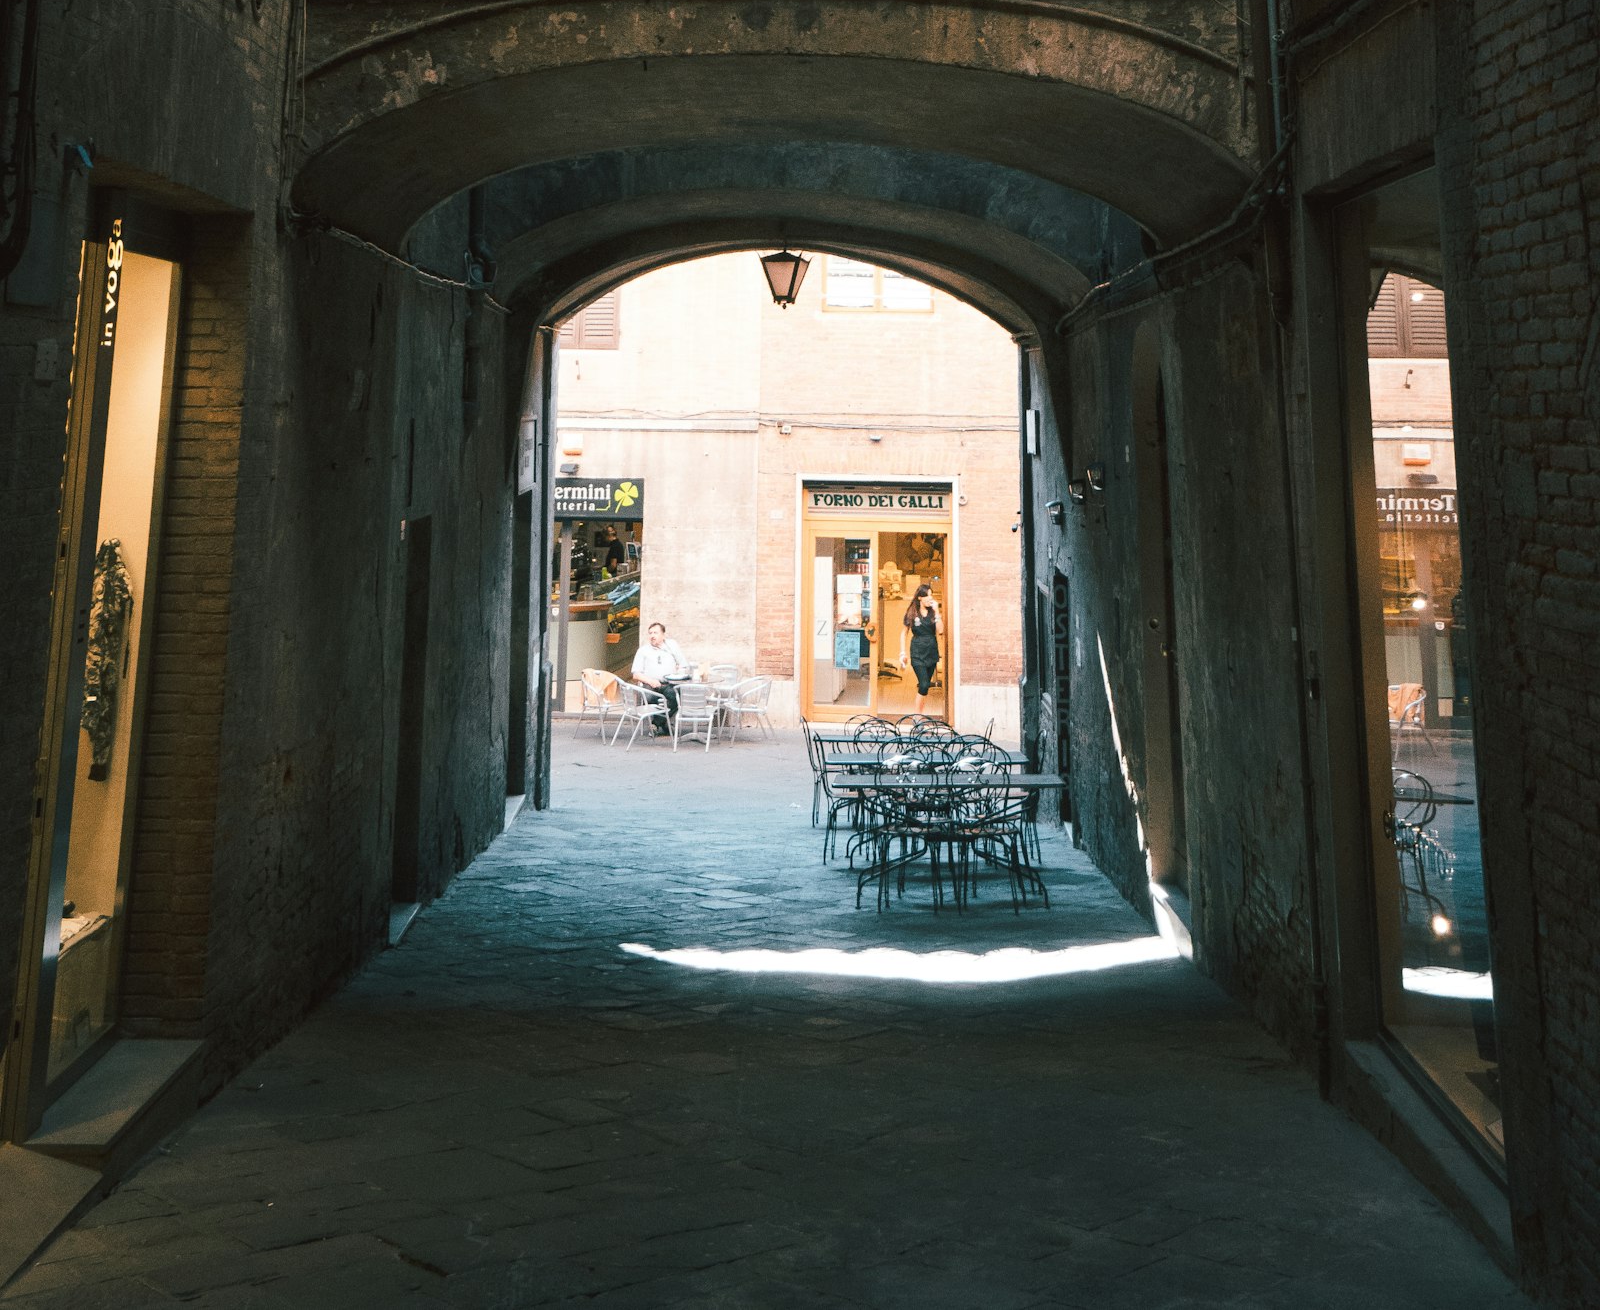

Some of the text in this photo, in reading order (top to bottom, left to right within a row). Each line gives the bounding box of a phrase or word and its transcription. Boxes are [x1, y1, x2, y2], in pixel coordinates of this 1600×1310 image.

[101, 218, 124, 346] in voga
[554, 483, 611, 500] ermini
[556, 501, 596, 511] tteria
[813, 493, 944, 509] FORNO DEI GALLI
